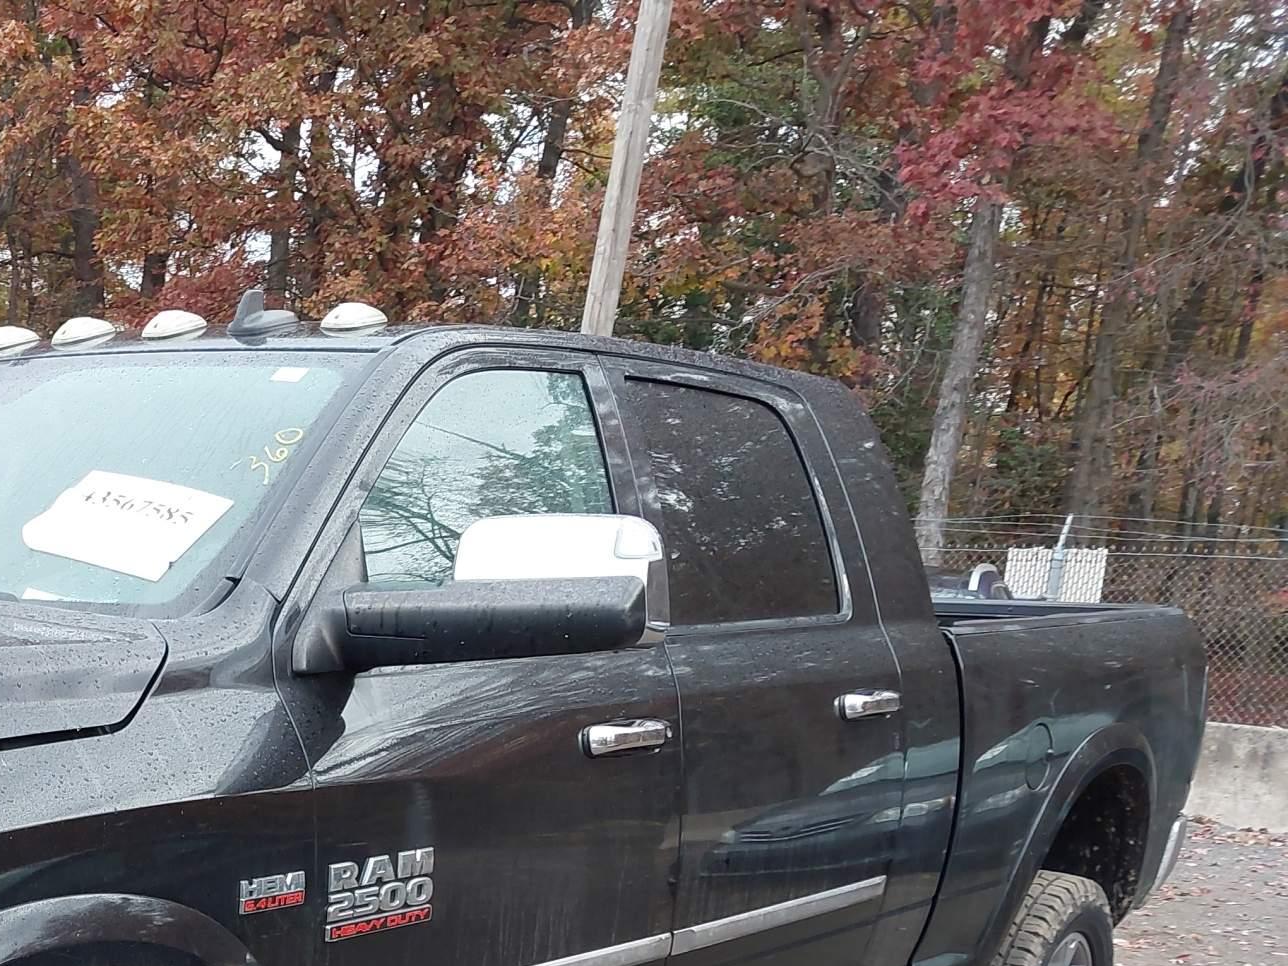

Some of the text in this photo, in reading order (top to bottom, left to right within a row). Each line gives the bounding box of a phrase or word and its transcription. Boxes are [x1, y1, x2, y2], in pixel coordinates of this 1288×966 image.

[249, 428, 304, 485] 360
[239, 870, 306, 899] HEMI
[328, 847, 434, 893] RAM
[326, 876, 433, 923] 2500
[331, 908, 429, 939] HEAVY DUTY
